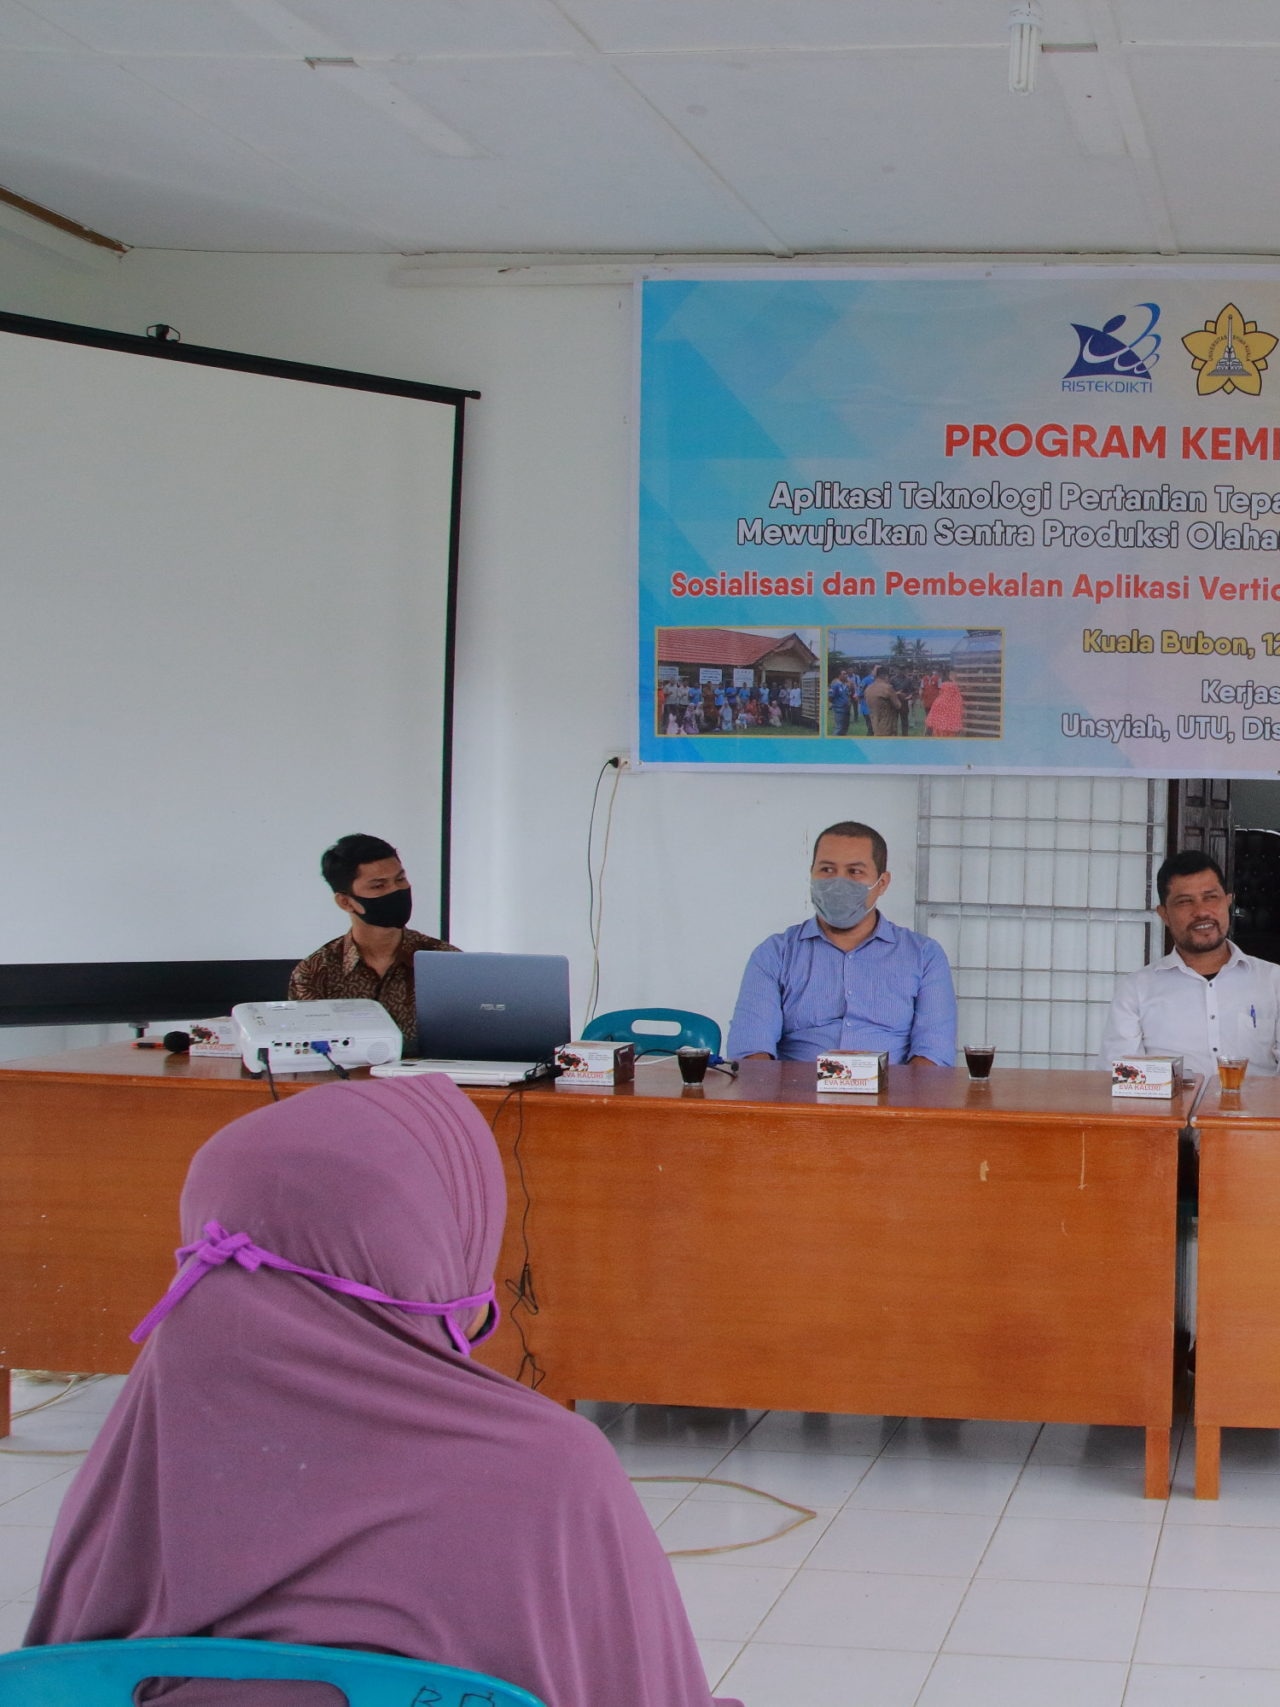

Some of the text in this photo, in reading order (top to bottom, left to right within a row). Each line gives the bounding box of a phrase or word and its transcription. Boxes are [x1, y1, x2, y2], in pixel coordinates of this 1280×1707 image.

[1061, 380, 1153, 393] RISTEKDIKTI
[944, 423, 1167, 459] PROGRAM
[769, 481, 892, 514] Aplikasi
[899, 481, 1051, 516] Teknologi
[1060, 482, 1207, 512] Pertanian
[737, 518, 927, 552] Mewujudkan
[934, 517, 1035, 546] Sentra
[1043, 519, 1179, 548] Produksi
[671, 571, 814, 597] Sosialisasi
[822, 571, 876, 596] dan
[886, 571, 1063, 598] Pembekalan
[1072, 574, 1190, 604] Aplikasi
[1082, 629, 1154, 654] Kuala
[1160, 630, 1256, 659] Bubon,
[1061, 713, 1170, 743] Unsyiah,
[1177, 716, 1236, 743] UTU,
[480, 1003, 506, 1011] ASUS
